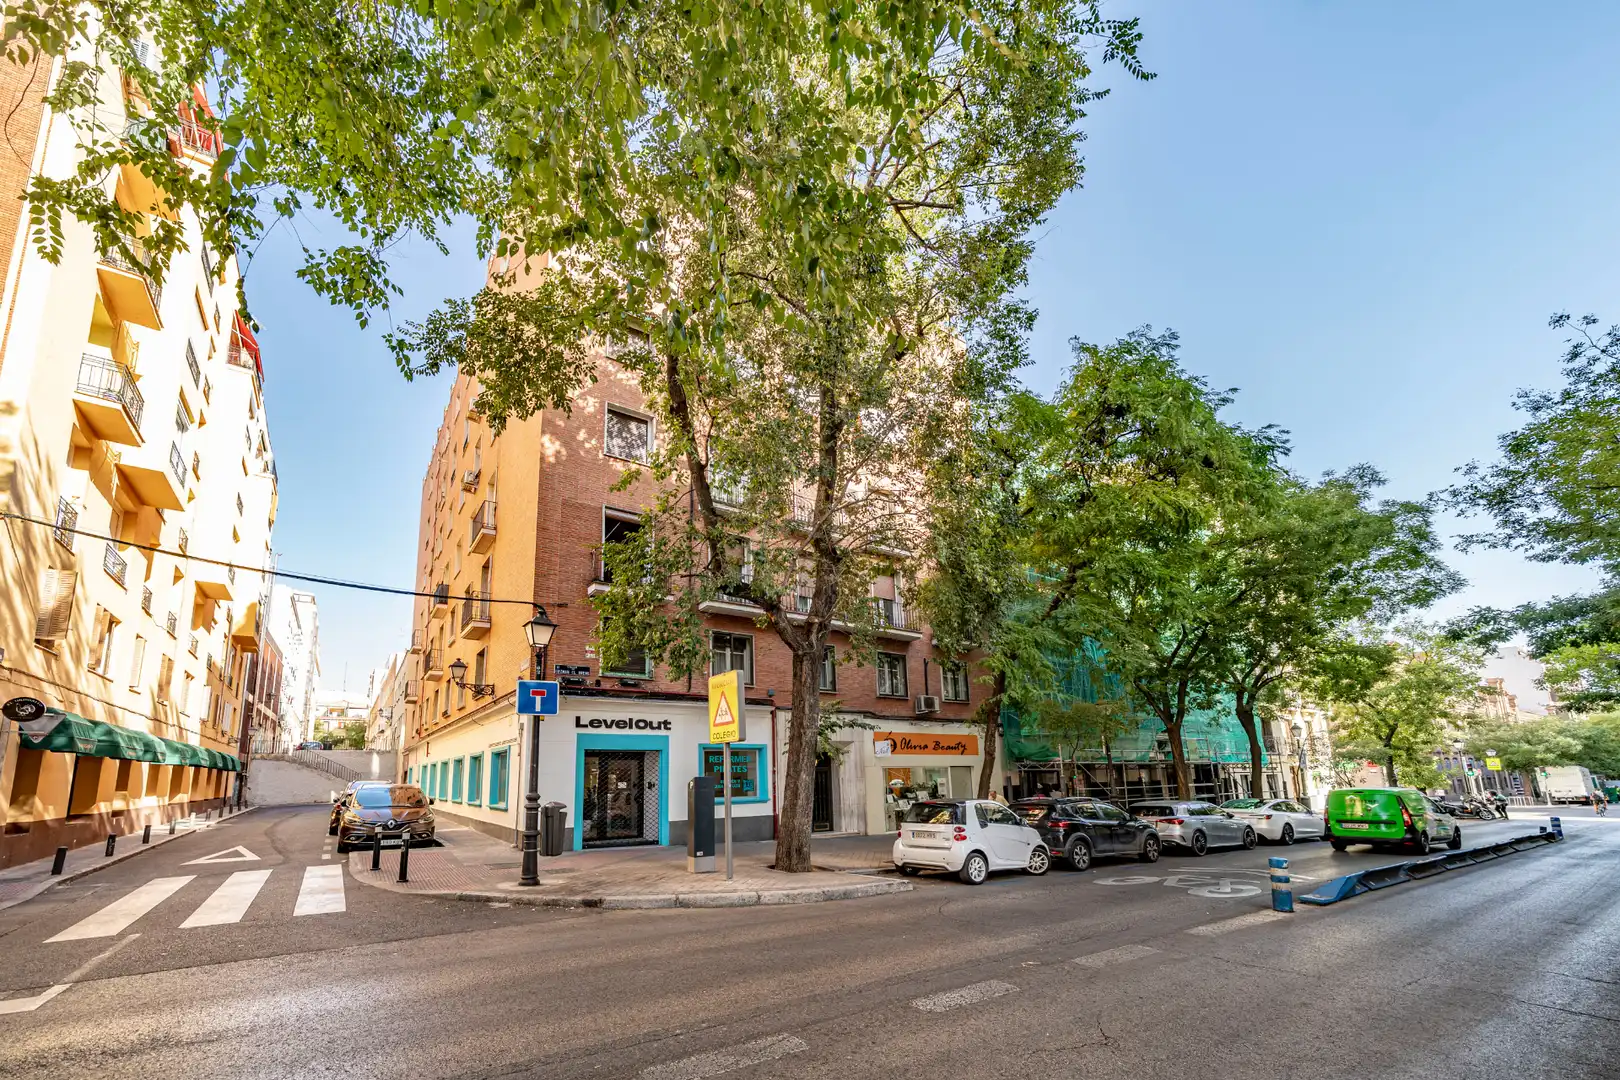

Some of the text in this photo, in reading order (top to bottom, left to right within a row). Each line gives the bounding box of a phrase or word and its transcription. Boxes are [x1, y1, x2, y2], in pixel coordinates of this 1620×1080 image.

[575, 716, 672, 731] LevelOut
[712, 730, 736, 740] COLEGIO
[900, 737, 968, 755] Olivia Beauty
[708, 755, 752, 763] REFRMER
[713, 765, 748, 773] PITES
